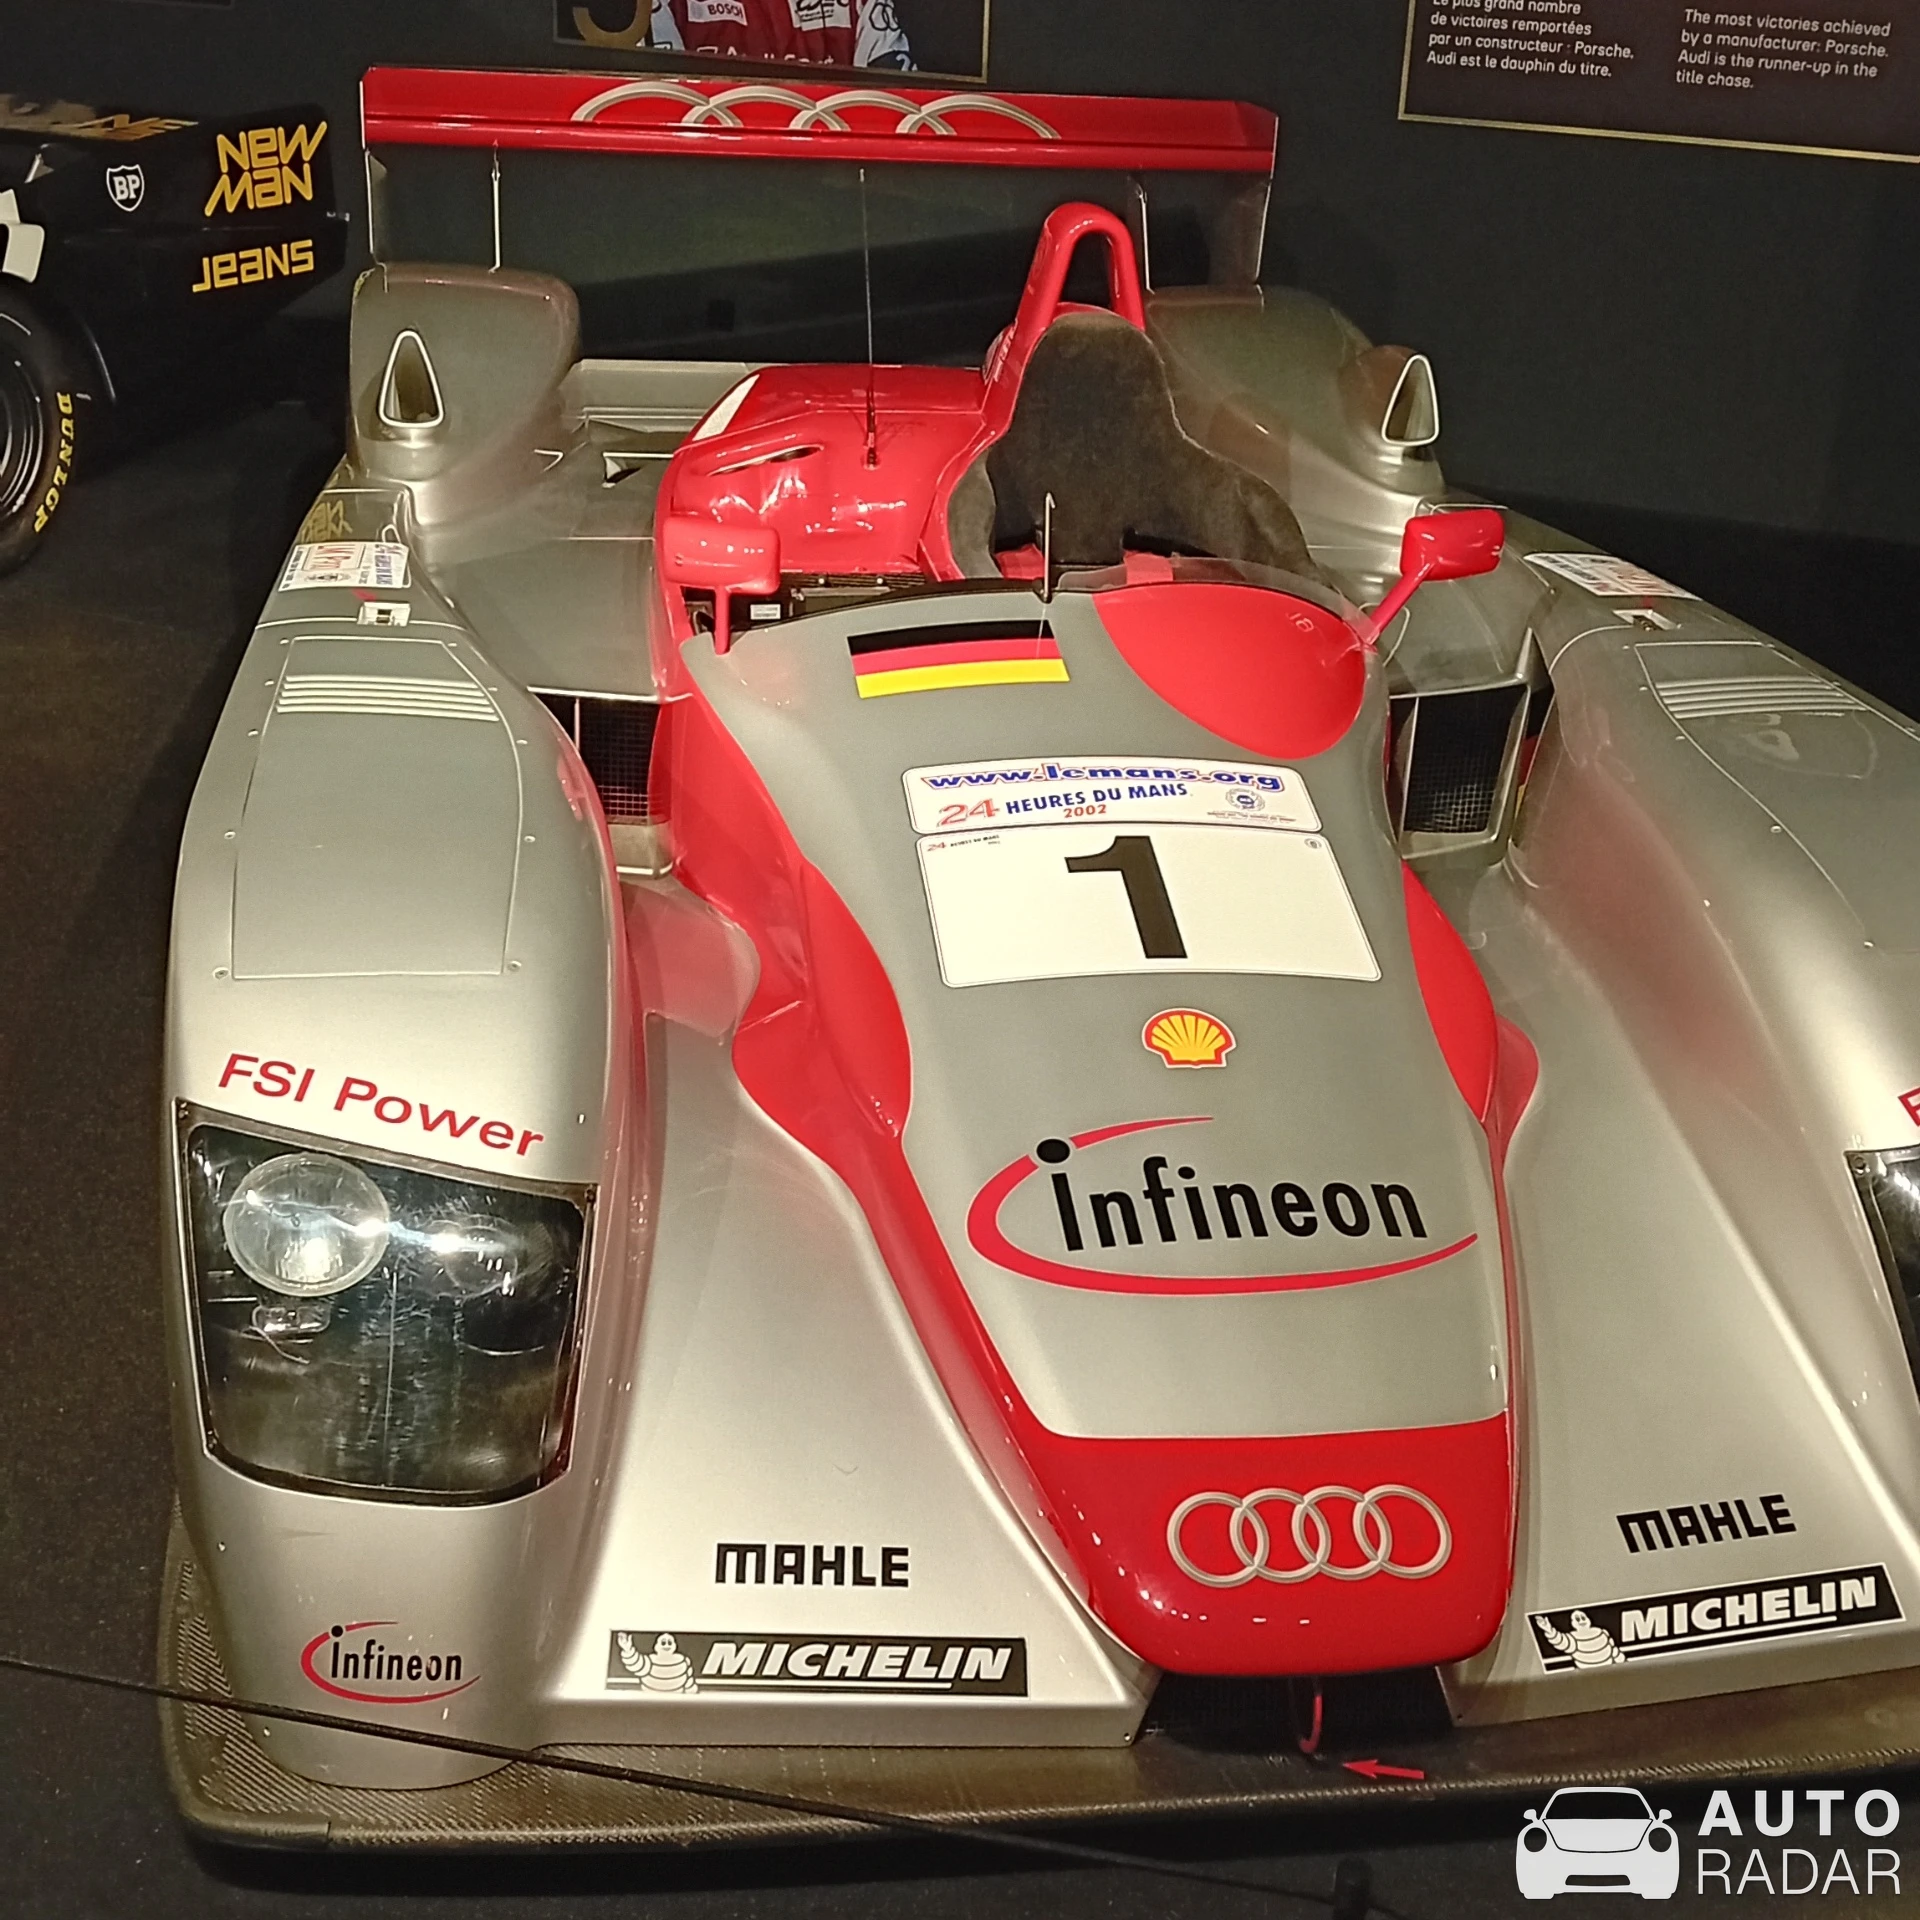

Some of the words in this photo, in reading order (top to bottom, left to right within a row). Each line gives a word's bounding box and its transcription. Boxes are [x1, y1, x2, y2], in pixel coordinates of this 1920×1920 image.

[1484, 0, 1525, 12] grand
[1528, 0, 1582, 15] nombre
[1430, 11, 1448, 26] de
[1450, 14, 1509, 30] victoires
[1512, 18, 1593, 36] remportées
[1684, 9, 1711, 24] The
[1714, 13, 1753, 28] most
[1756, 15, 1820, 32] victories
[1823, 19, 1892, 37] achieved
[1428, 33, 1451, 48] par
[1455, 35, 1473, 46] un
[1475, 36, 1564, 53] constructeur
[1680, 29, 1700, 47] by
[1703, 34, 1713, 45] a
[1716, 33, 1822, 54] manufacturer:
[1825, 38, 1890, 58] Porsche.
[1427, 50, 1457, 65] Audi
[1459, 54, 1482, 68] est
[1484, 55, 1498, 69] le
[1500, 56, 1556, 75] dauphin
[1558, 60, 1577, 74] du
[1580, 61, 1613, 78] titre.
[1677, 49, 1711, 65] Audi
[1714, 53, 1727, 66] is
[1730, 53, 1754, 68] the
[1757, 58, 1832, 78] runner-up
[1834, 61, 1849, 76] in
[1853, 63, 1878, 78] the
[1675, 69, 1704, 84] title
[1706, 73, 1754, 89] chase.
[113, 174, 141, 201] BP
[34, 391, 75, 533] DUNLOP
[921, 762, 1286, 793] www.lemans.org
[936, 798, 1001, 828] 24
[1005, 791, 1087, 815] HEURES
[1093, 784, 1122, 803] DU
[1128, 783, 1188, 800] MANS
[1063, 804, 1108, 819] 2002
[1064, 835, 1188, 959] 1
[218, 1053, 316, 1102] FSI
[333, 1077, 545, 1156] Power
[1616, 1494, 1798, 1553] MAHLE
[715, 1542, 909, 1588] MAHLE
[1620, 1576, 1877, 1643] MICHELIN
[701, 1642, 1012, 1681] MICHELIN
